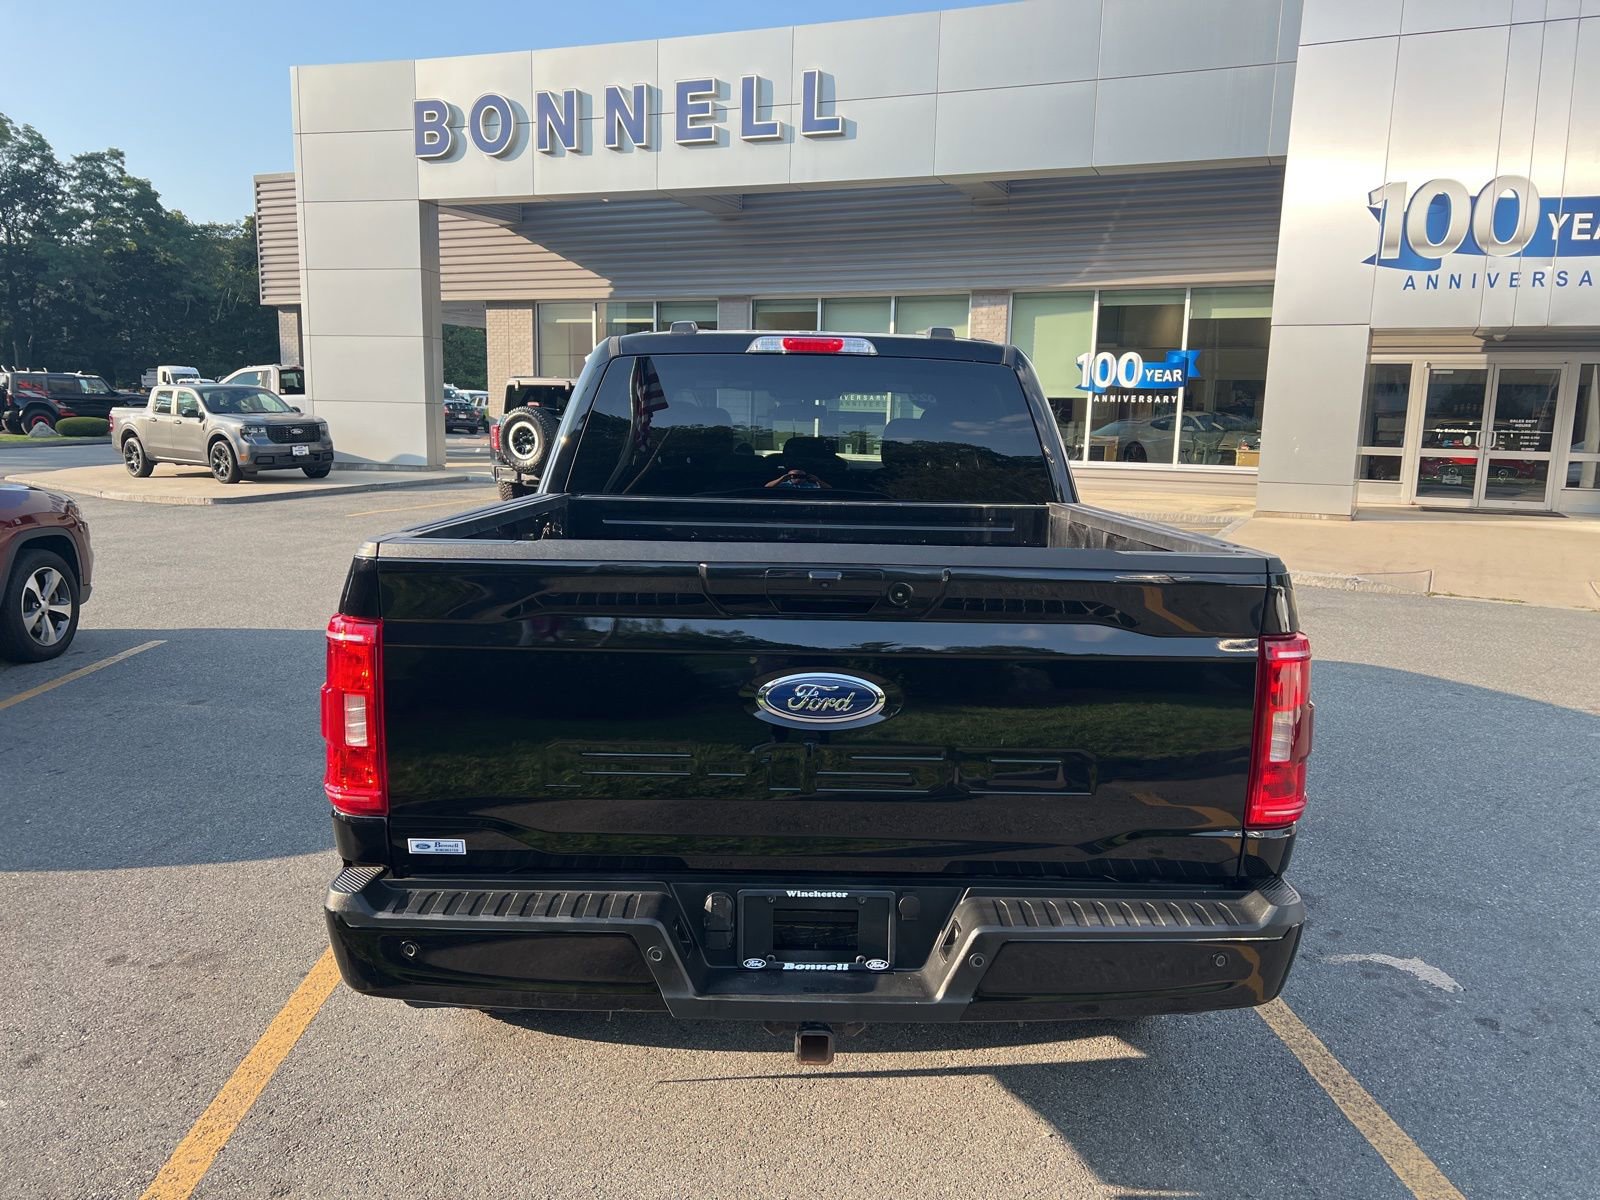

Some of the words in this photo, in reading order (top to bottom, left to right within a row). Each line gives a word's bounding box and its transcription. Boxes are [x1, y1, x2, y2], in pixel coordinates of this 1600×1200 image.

[413, 68, 845, 158] BONNELL
[1367, 174, 1541, 260] 100
[1402, 270, 1594, 291] ANNIVERSA
[1076, 351, 1144, 388] 100
[1145, 368, 1182, 383] YEAR
[1093, 394, 1178, 404] ANNIVERSARY
[787, 683, 856, 712] Ford
[785, 890, 849, 898] Winchester
[782, 962, 849, 971] Bonnell
